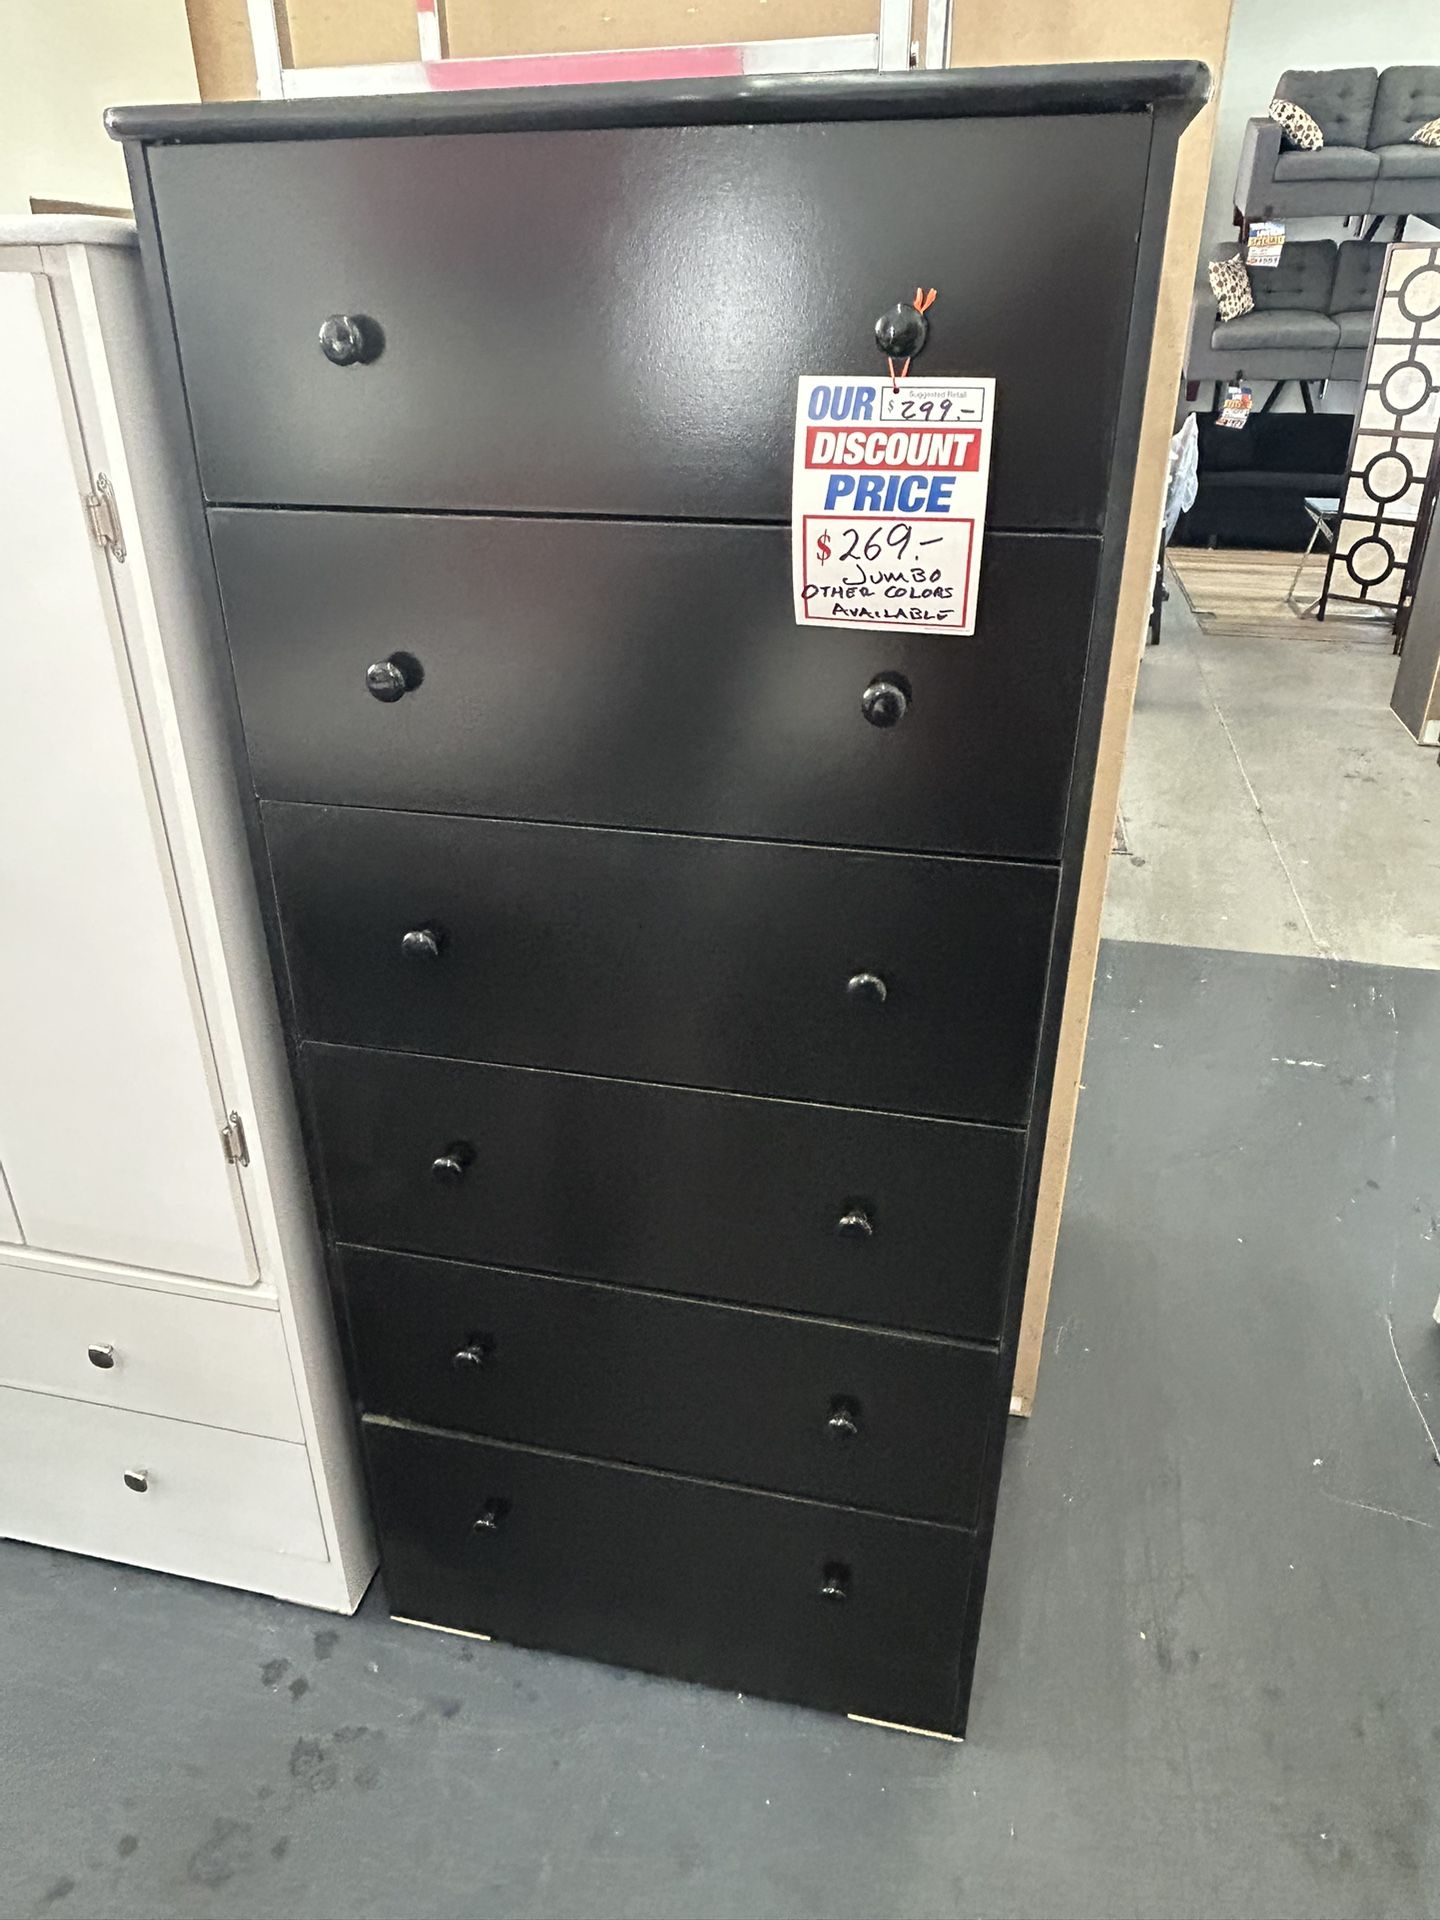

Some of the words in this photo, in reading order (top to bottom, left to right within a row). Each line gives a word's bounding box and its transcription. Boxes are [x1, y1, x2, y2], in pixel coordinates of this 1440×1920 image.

[808, 385, 876, 421] OUR
[909, 390, 945, 399] Suggested
[947, 390, 967, 399] Retail
[811, 431, 975, 467] DISCOUNT
[824, 474, 956, 513] PRICE
[842, 564, 942, 586] JUMBO
[801, 584, 875, 600] OTHER
[885, 586, 954, 599] COLORS
[832, 603, 954, 620] AVAILABLE
